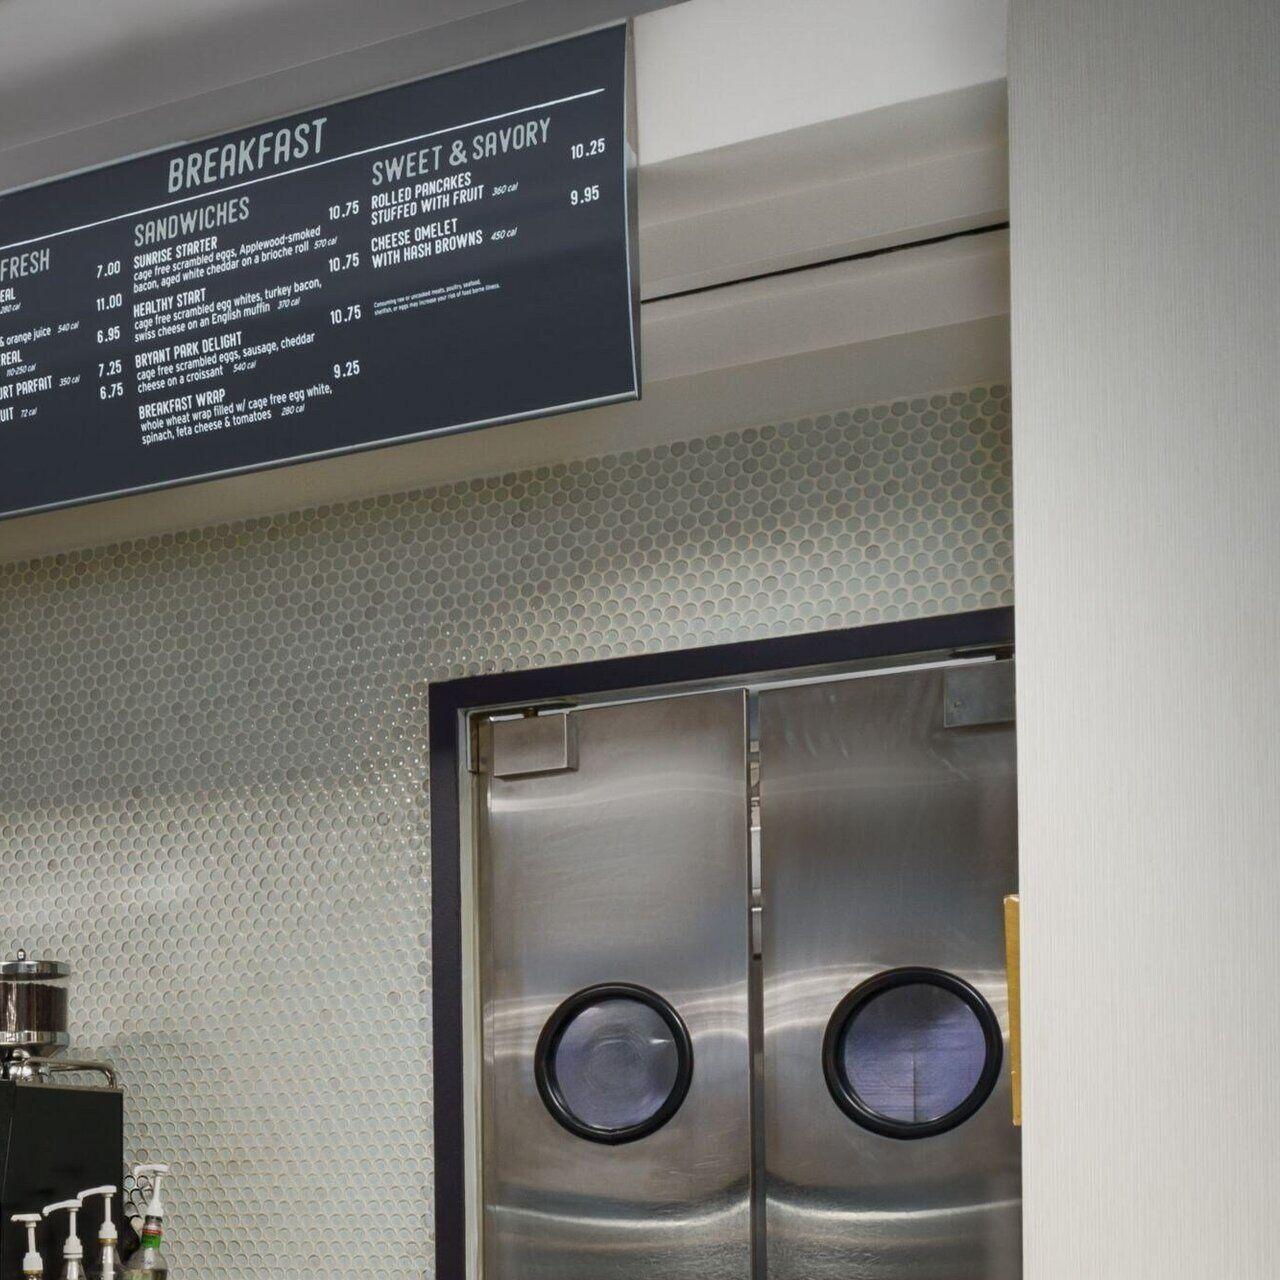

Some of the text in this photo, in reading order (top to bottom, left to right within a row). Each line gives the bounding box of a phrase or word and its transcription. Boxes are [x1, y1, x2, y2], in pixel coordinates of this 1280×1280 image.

[167, 117, 327, 193] BREAKFAST
[371, 117, 550, 186] SWEET & SAVORY
[570, 137, 605, 159] 10.25
[370, 201, 417, 226] STUFFED
[420, 193, 450, 213] WITH
[452, 184, 484, 206] FRUIT
[371, 171, 471, 209] ROLLED PANCAKES
[570, 184, 599, 205] 9.95
[134, 196, 249, 247] SANDWICHES
[328, 199, 359, 220] 10.75
[371, 217, 458, 252] CHEESE OMELET
[371, 248, 400, 269] WITH
[403, 241, 432, 262] HASH
[434, 229, 483, 254] BROWNS
[0, 247, 50, 282] FRESH
[133, 236, 217, 269] SUNRISE STARTER
[133, 224, 321, 281] cage free scrambled eggs, Applewood-smoked
[133, 279, 159, 294] bacon,
[160, 271, 181, 287] aged
[181, 267, 205, 281] white
[205, 259, 240, 276] cheddar
[241, 256, 253, 267] on
[253, 254, 260, 264] a
[261, 245, 293, 262] brioche
[294, 240, 309, 254] roll
[328, 252, 359, 272] 10.75
[96, 260, 121, 278] 7.00
[96, 292, 122, 311] 11.00
[133, 287, 206, 318] HEALTHY START
[329, 304, 361, 324] 10.75
[5, 331, 32, 346] orange
[32, 326, 52, 341] juice
[96, 325, 120, 344] 6.95
[134, 328, 156, 343] swiss
[157, 322, 186, 337] cheese
[187, 319, 198, 330] on
[199, 316, 210, 328] an
[211, 307, 242, 325] English
[243, 301, 271, 317] muffin
[134, 330, 242, 368] BRYANT PARK DELIGHT
[98, 359, 122, 377] 7.25
[333, 359, 360, 379] 9.25
[15, 374, 52, 396] PARFAIT
[99, 381, 123, 400] 6.75
[138, 388, 225, 420] BREAKFAST WRAP
[140, 383, 332, 432] whole wheat wrap filled w/ cage free egg white,
